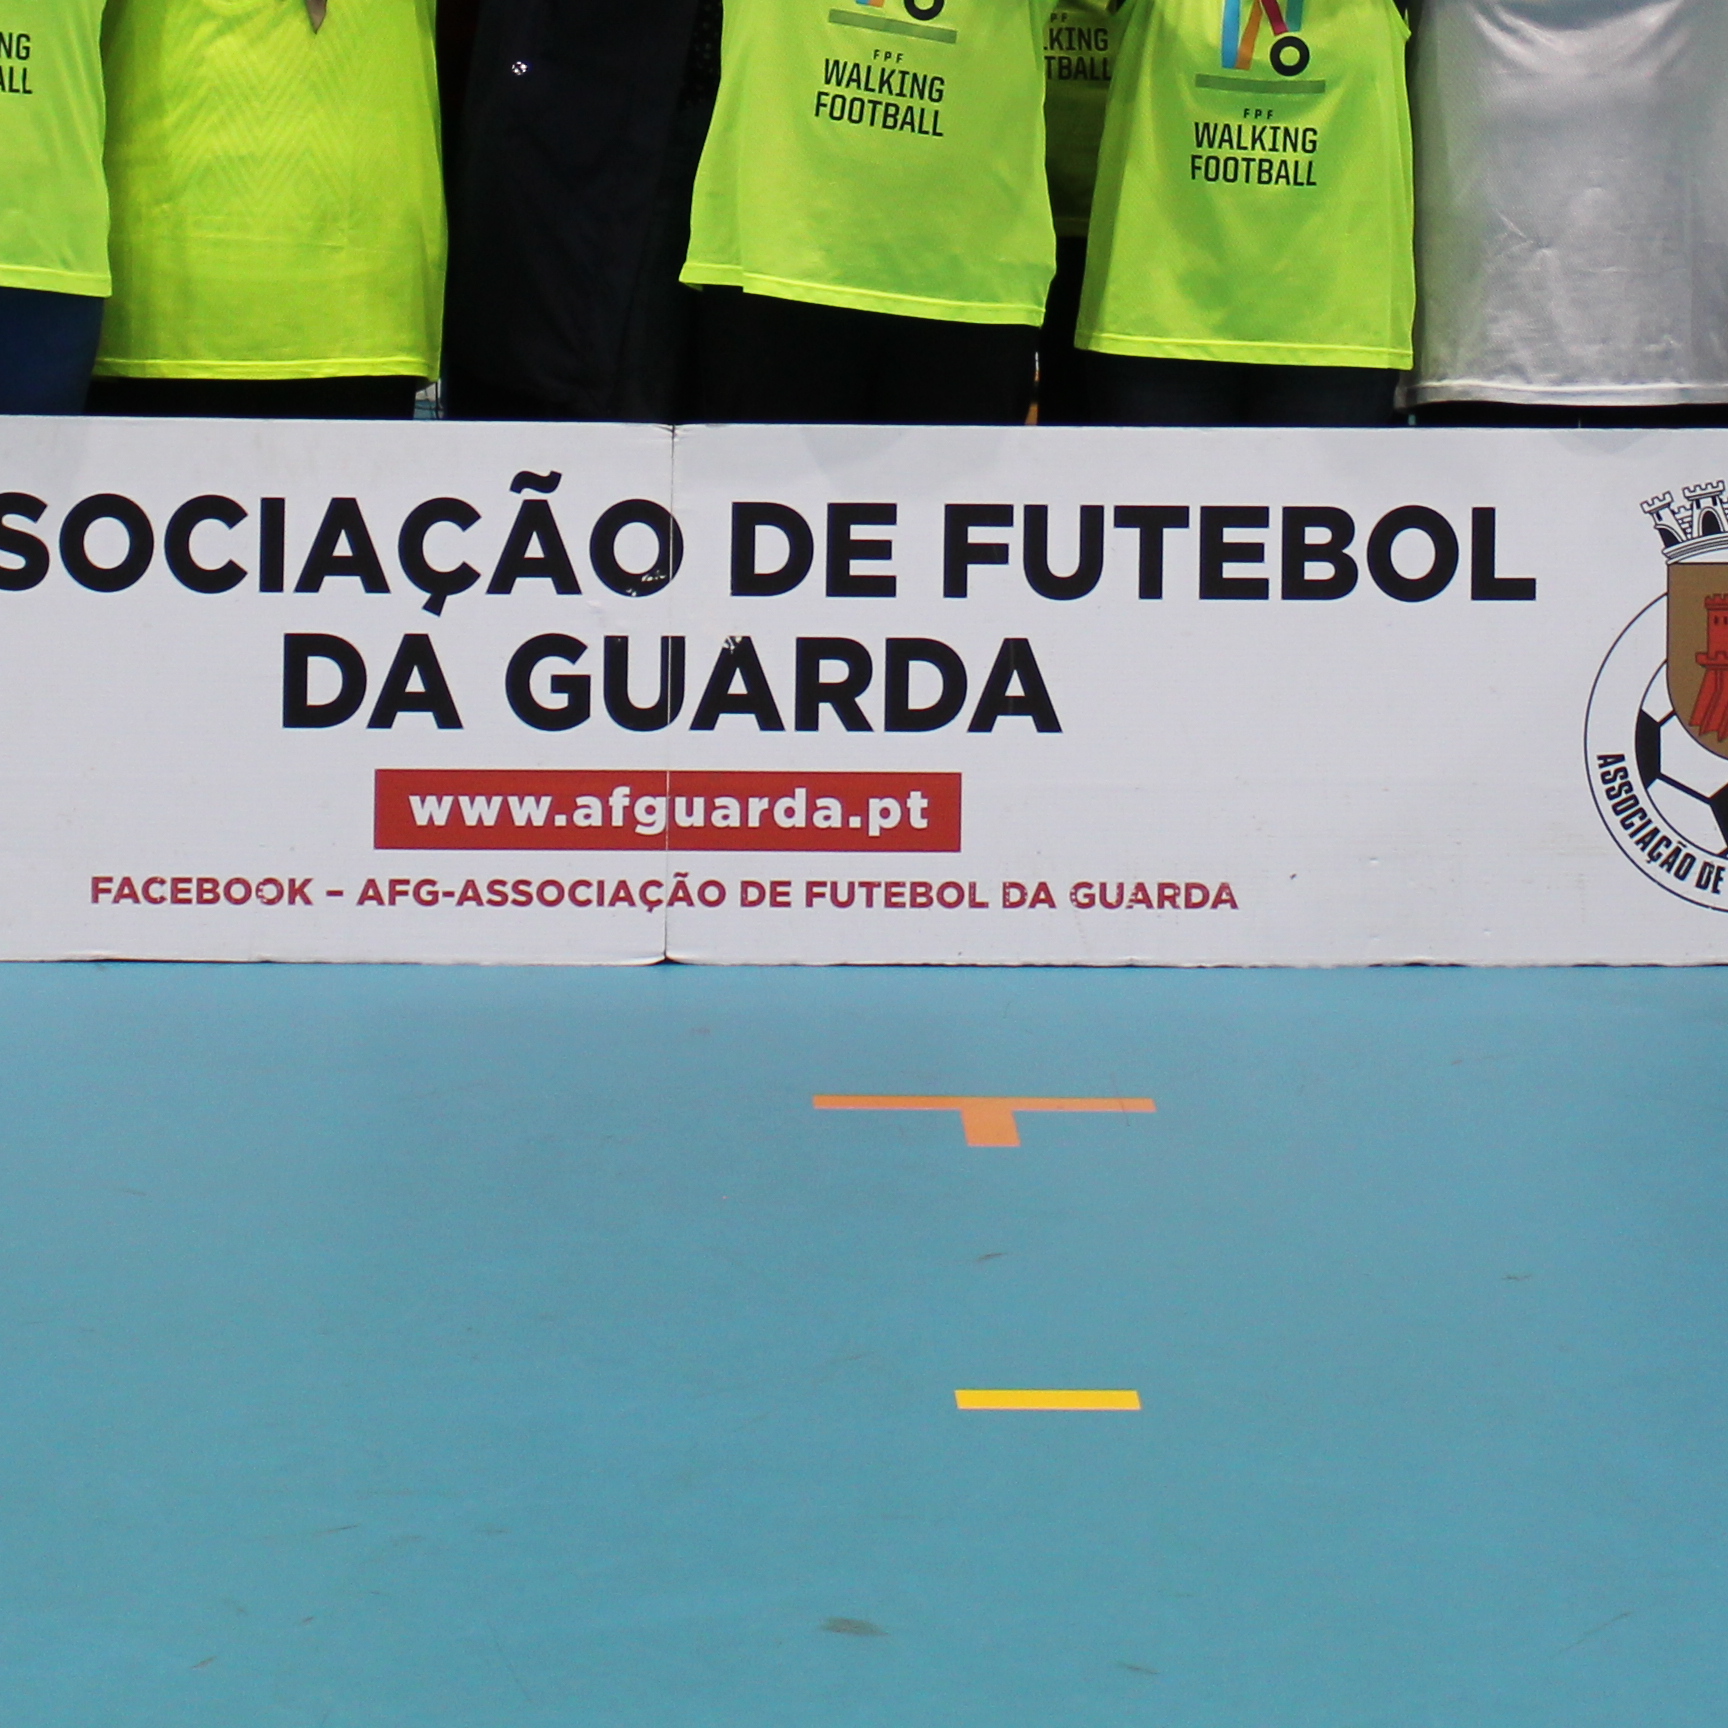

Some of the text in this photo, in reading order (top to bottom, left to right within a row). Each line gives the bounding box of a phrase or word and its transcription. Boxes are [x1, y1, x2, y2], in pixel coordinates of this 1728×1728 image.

[1044, 27, 1109, 51] KING
[823, 58, 946, 103] WALKING
[1044, 56, 1112, 80] TBALL
[814, 91, 945, 137] FOOTBALL
[1194, 121, 1318, 154] WALKING
[1190, 154, 1318, 187] FOOTBALL
[731, 502, 897, 598] DE
[943, 504, 1536, 602] FUTEBOL
[283, 633, 1062, 733] DA GUARDA
[409, 786, 928, 837] www.afguarda.pt
[1597, 753, 1696, 881] ASSOCIAÇÃO
[1695, 860, 1726, 895] DE
[91, 876, 313, 906] FACEBOOK
[358, 872, 727, 912] AFG-ASSOCIAÇÃO
[740, 879, 792, 908] DE
[805, 880, 989, 909] FUTEBOL
[1002, 881, 1057, 909] DA
[1070, 880, 1240, 910] GUARDA
